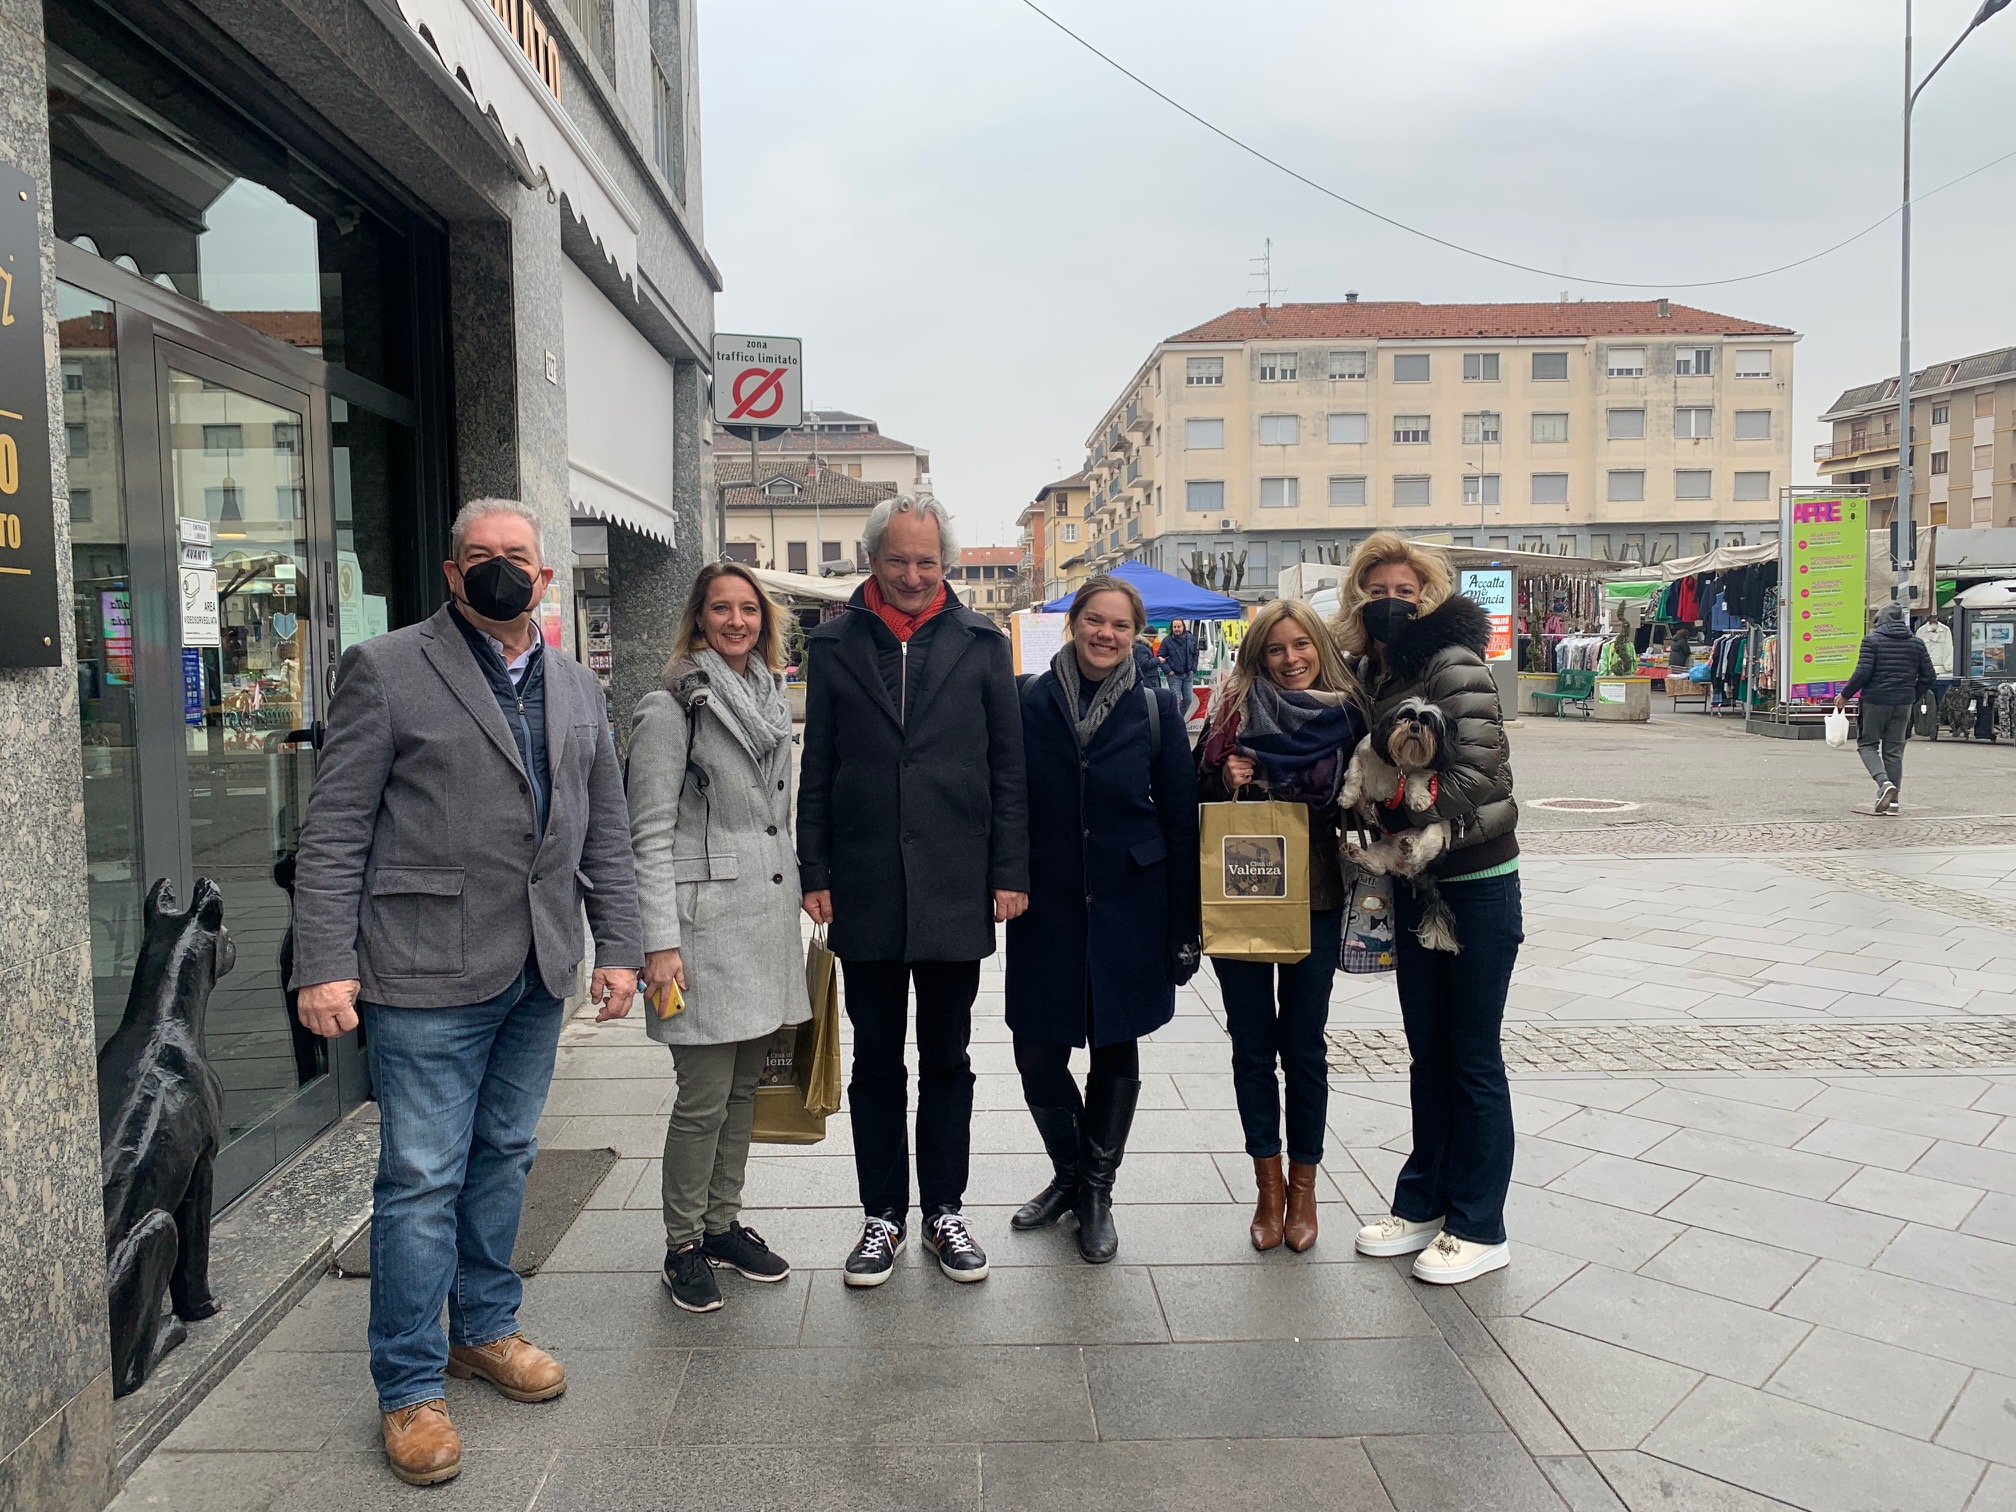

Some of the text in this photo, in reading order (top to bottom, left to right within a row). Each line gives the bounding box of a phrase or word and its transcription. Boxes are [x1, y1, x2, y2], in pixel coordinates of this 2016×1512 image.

[746, 341, 768, 349] zona
[717, 351, 798, 365] traffico limitato
[186, 548, 208, 562] AVANTI
[1468, 574, 1505, 589] Accatta
[204, 601, 216, 612] AREA
[1228, 864, 1282, 875] Valenza
[766, 1057, 793, 1067] lenz
